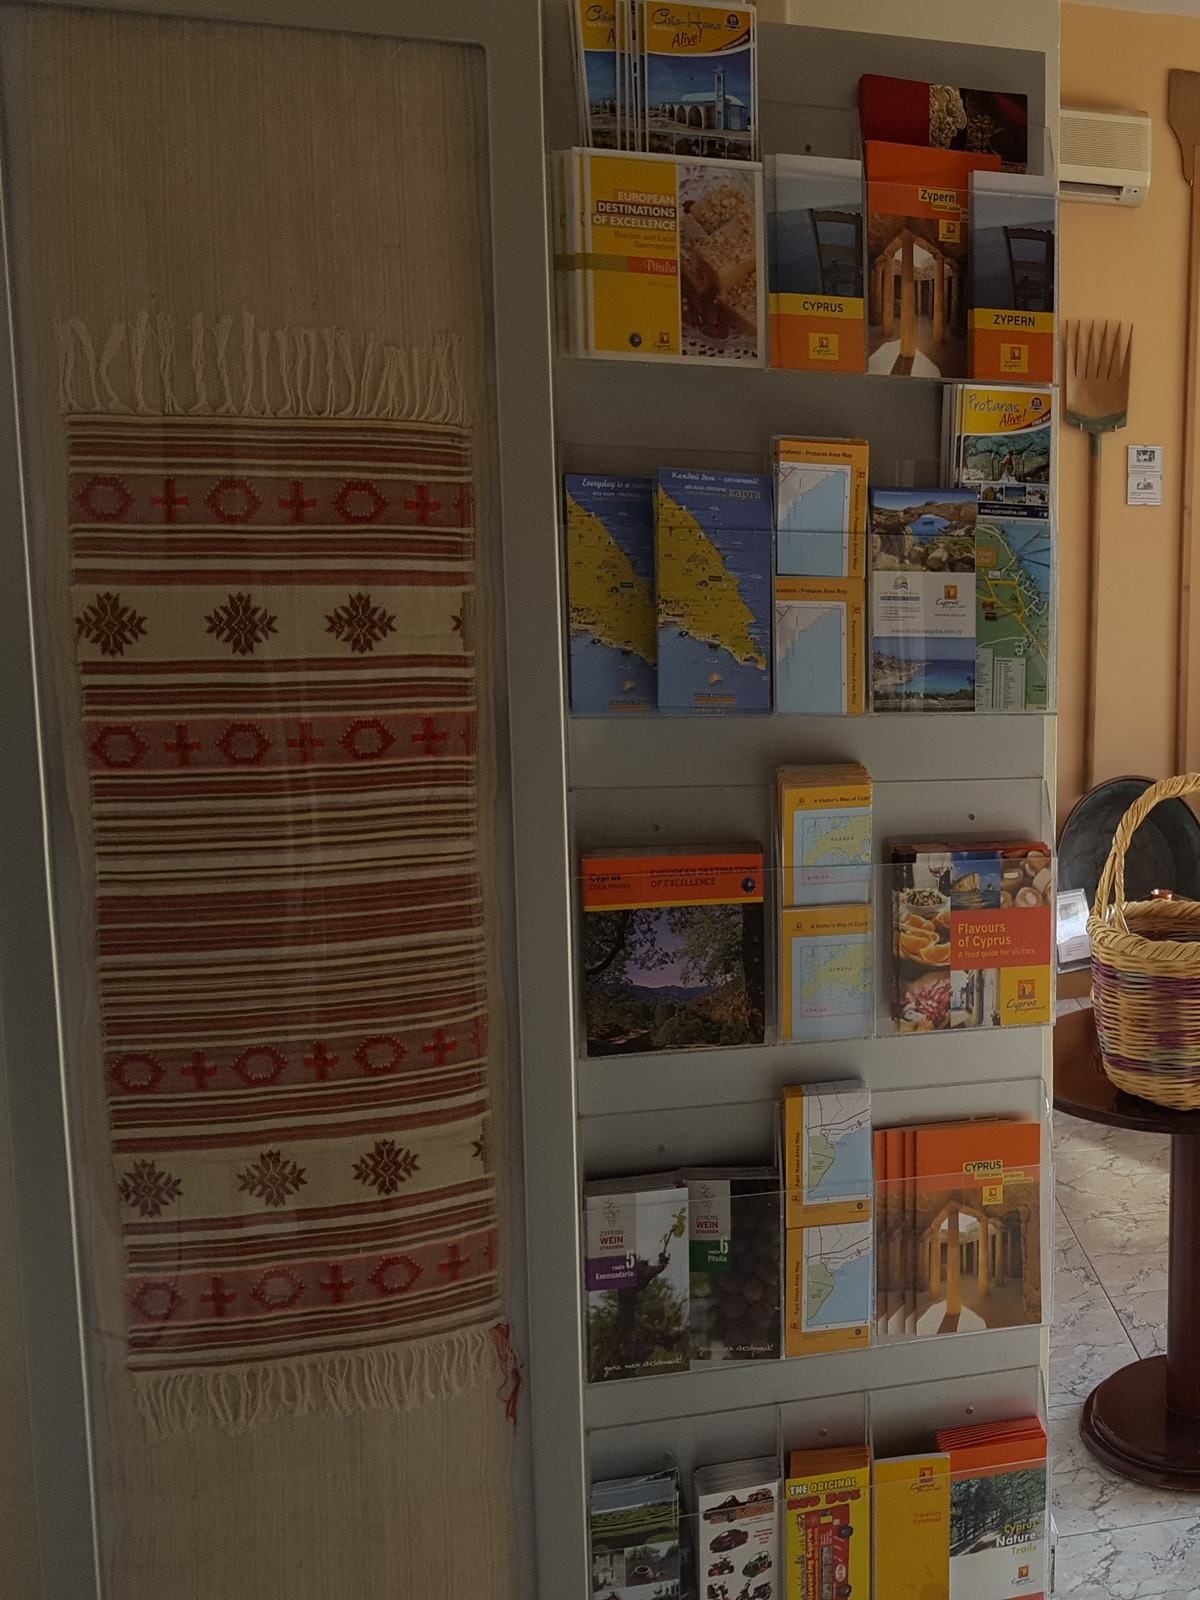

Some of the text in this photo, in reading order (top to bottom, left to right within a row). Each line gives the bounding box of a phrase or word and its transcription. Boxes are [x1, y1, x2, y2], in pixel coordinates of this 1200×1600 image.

[672, 29, 704, 48] Alive!
[617, 192, 675, 205] EUROPEAN
[921, 189, 955, 203] Zypern
[598, 202, 676, 218] DESTINATIONS
[593, 215, 676, 231] OF EXCELLENCE
[803, 301, 844, 313] CYPRUS
[994, 314, 1035, 327] ZYPERN
[969, 394, 1020, 413] Protaras
[999, 409, 1027, 427] Alive!
[582, 477, 616, 489] Everyday
[728, 486, 761, 501] карта
[589, 874, 621, 884] Cyprus
[651, 878, 716, 889] OF EXCELLENCE
[958, 923, 1006, 935] Flavours
[958, 936, 1012, 949] of Cyprus
[981, 950, 1000, 960] guide
[1006, 998, 1038, 1011] Cyprus
[965, 1161, 1002, 1172] CYPRUS
[696, 1221, 719, 1229] WEIN
[600, 1236, 624, 1245] WEIN
[720, 1235, 729, 1255] 6
[626, 1250, 635, 1269] 5
[789, 1477, 857, 1496] THE ORIGINAL
[1004, 1522, 1037, 1536] Cyprus
[995, 1532, 1037, 1548] Nature
[1012, 1543, 1037, 1556] Trails
